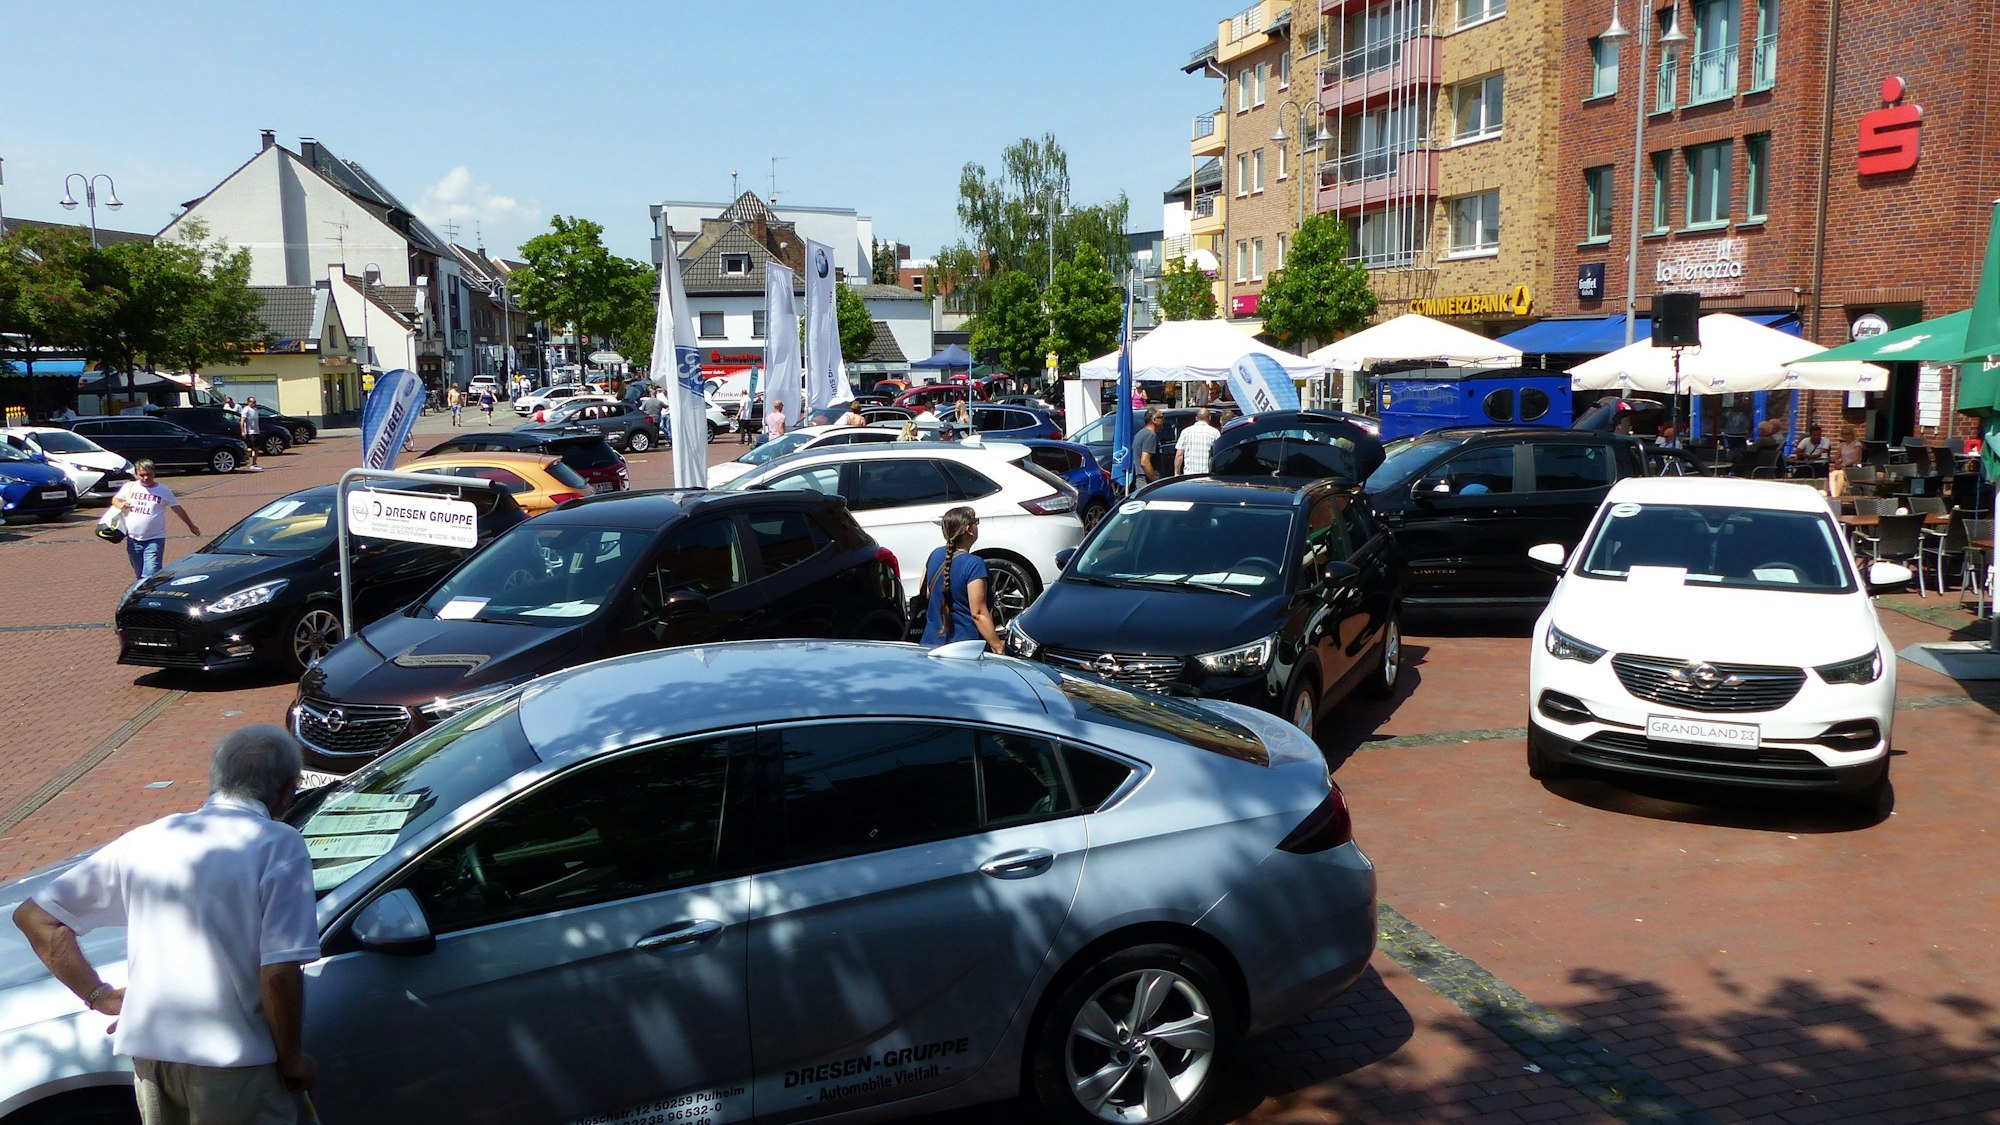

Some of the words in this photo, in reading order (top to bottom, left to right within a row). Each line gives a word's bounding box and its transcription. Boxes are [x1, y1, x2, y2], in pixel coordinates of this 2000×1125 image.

[1656, 259, 1672, 282] La
[1677, 256, 1742, 281] Terrazza
[1578, 278, 1597, 290] Gaffel
[1409, 293, 1509, 316] COMMERZBANK
[129, 505, 152, 515] CHILL
[385, 506, 427, 520] DRESEN
[429, 511, 474, 526] GRUPPE
[1651, 721, 1738, 740] GRANDLAND
[819, 1077, 892, 1102] Automobile
[894, 1064, 941, 1085] Vielfalt
[654, 1095, 693, 1111] 50259
[696, 1086, 745, 1103] Pulheim
